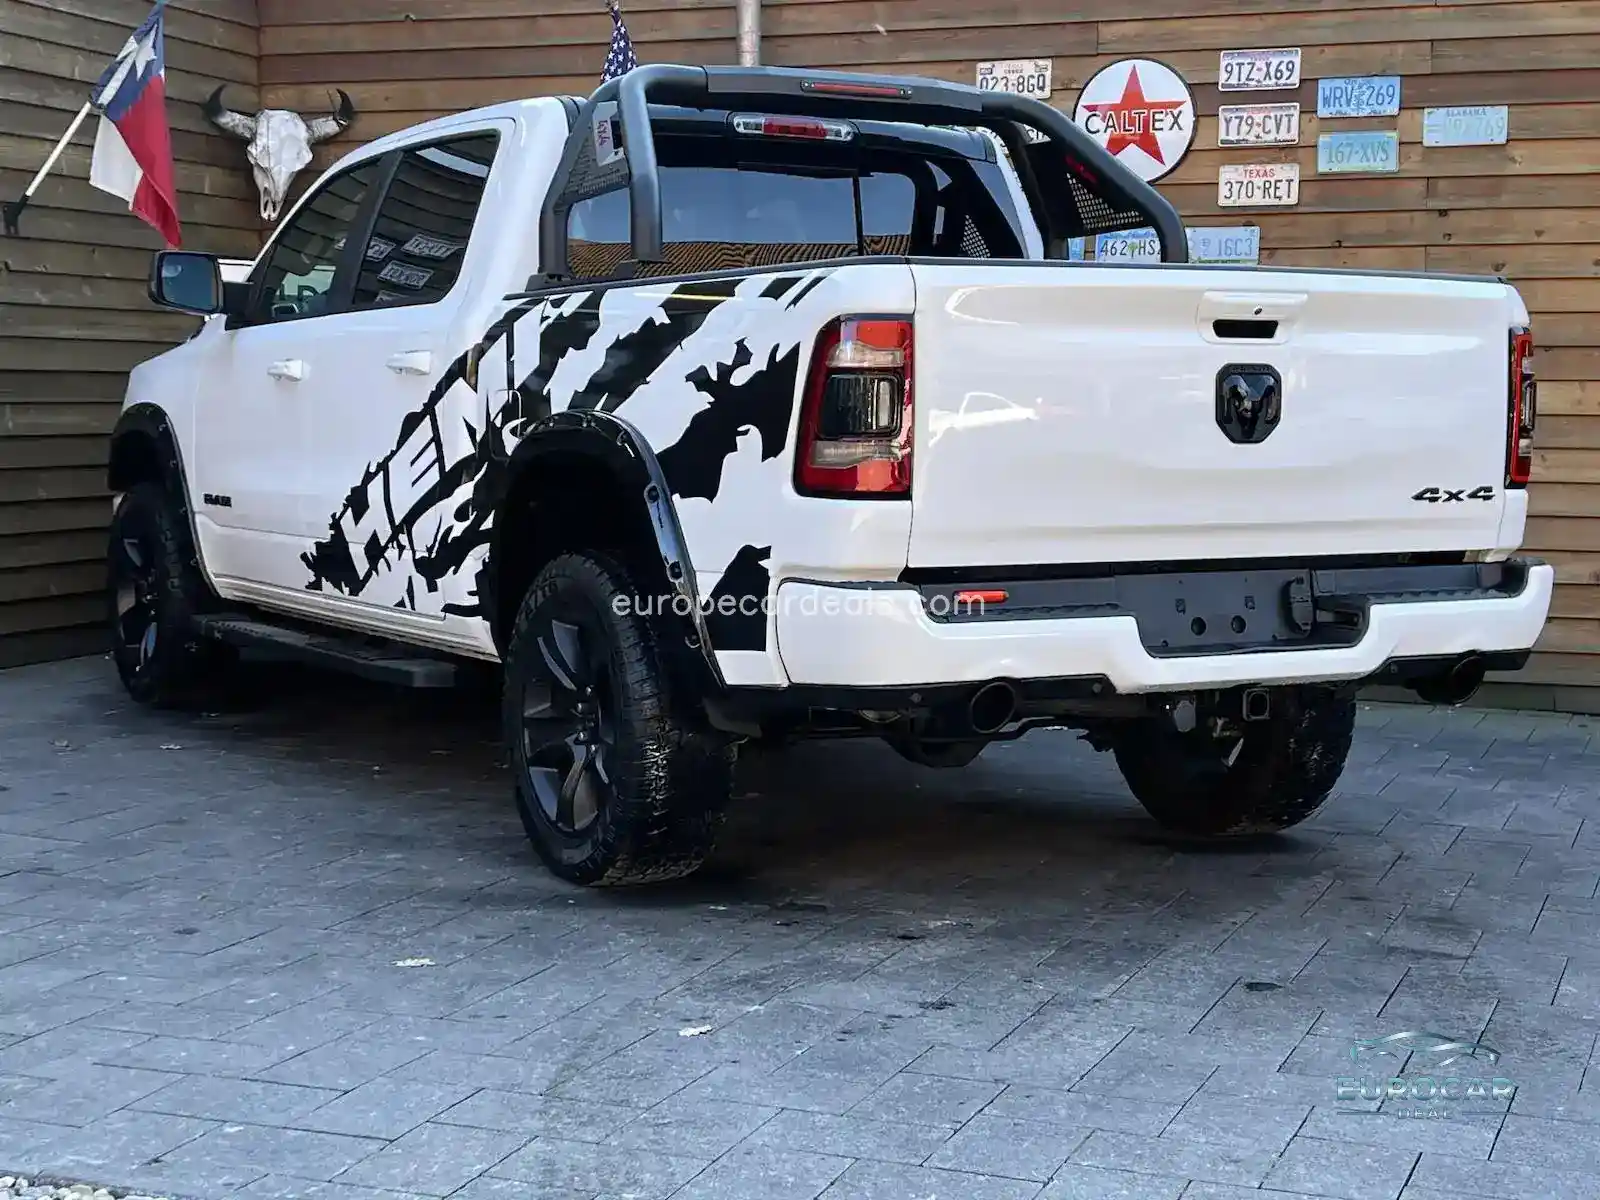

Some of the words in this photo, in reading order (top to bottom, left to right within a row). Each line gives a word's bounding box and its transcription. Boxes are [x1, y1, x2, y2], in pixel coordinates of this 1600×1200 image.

[1084, 110, 1184, 135] CALTEX
[1243, 168, 1276, 179] TEXAS
[1138, 238, 1161, 256] HS
[1410, 485, 1496, 503] 4x4
